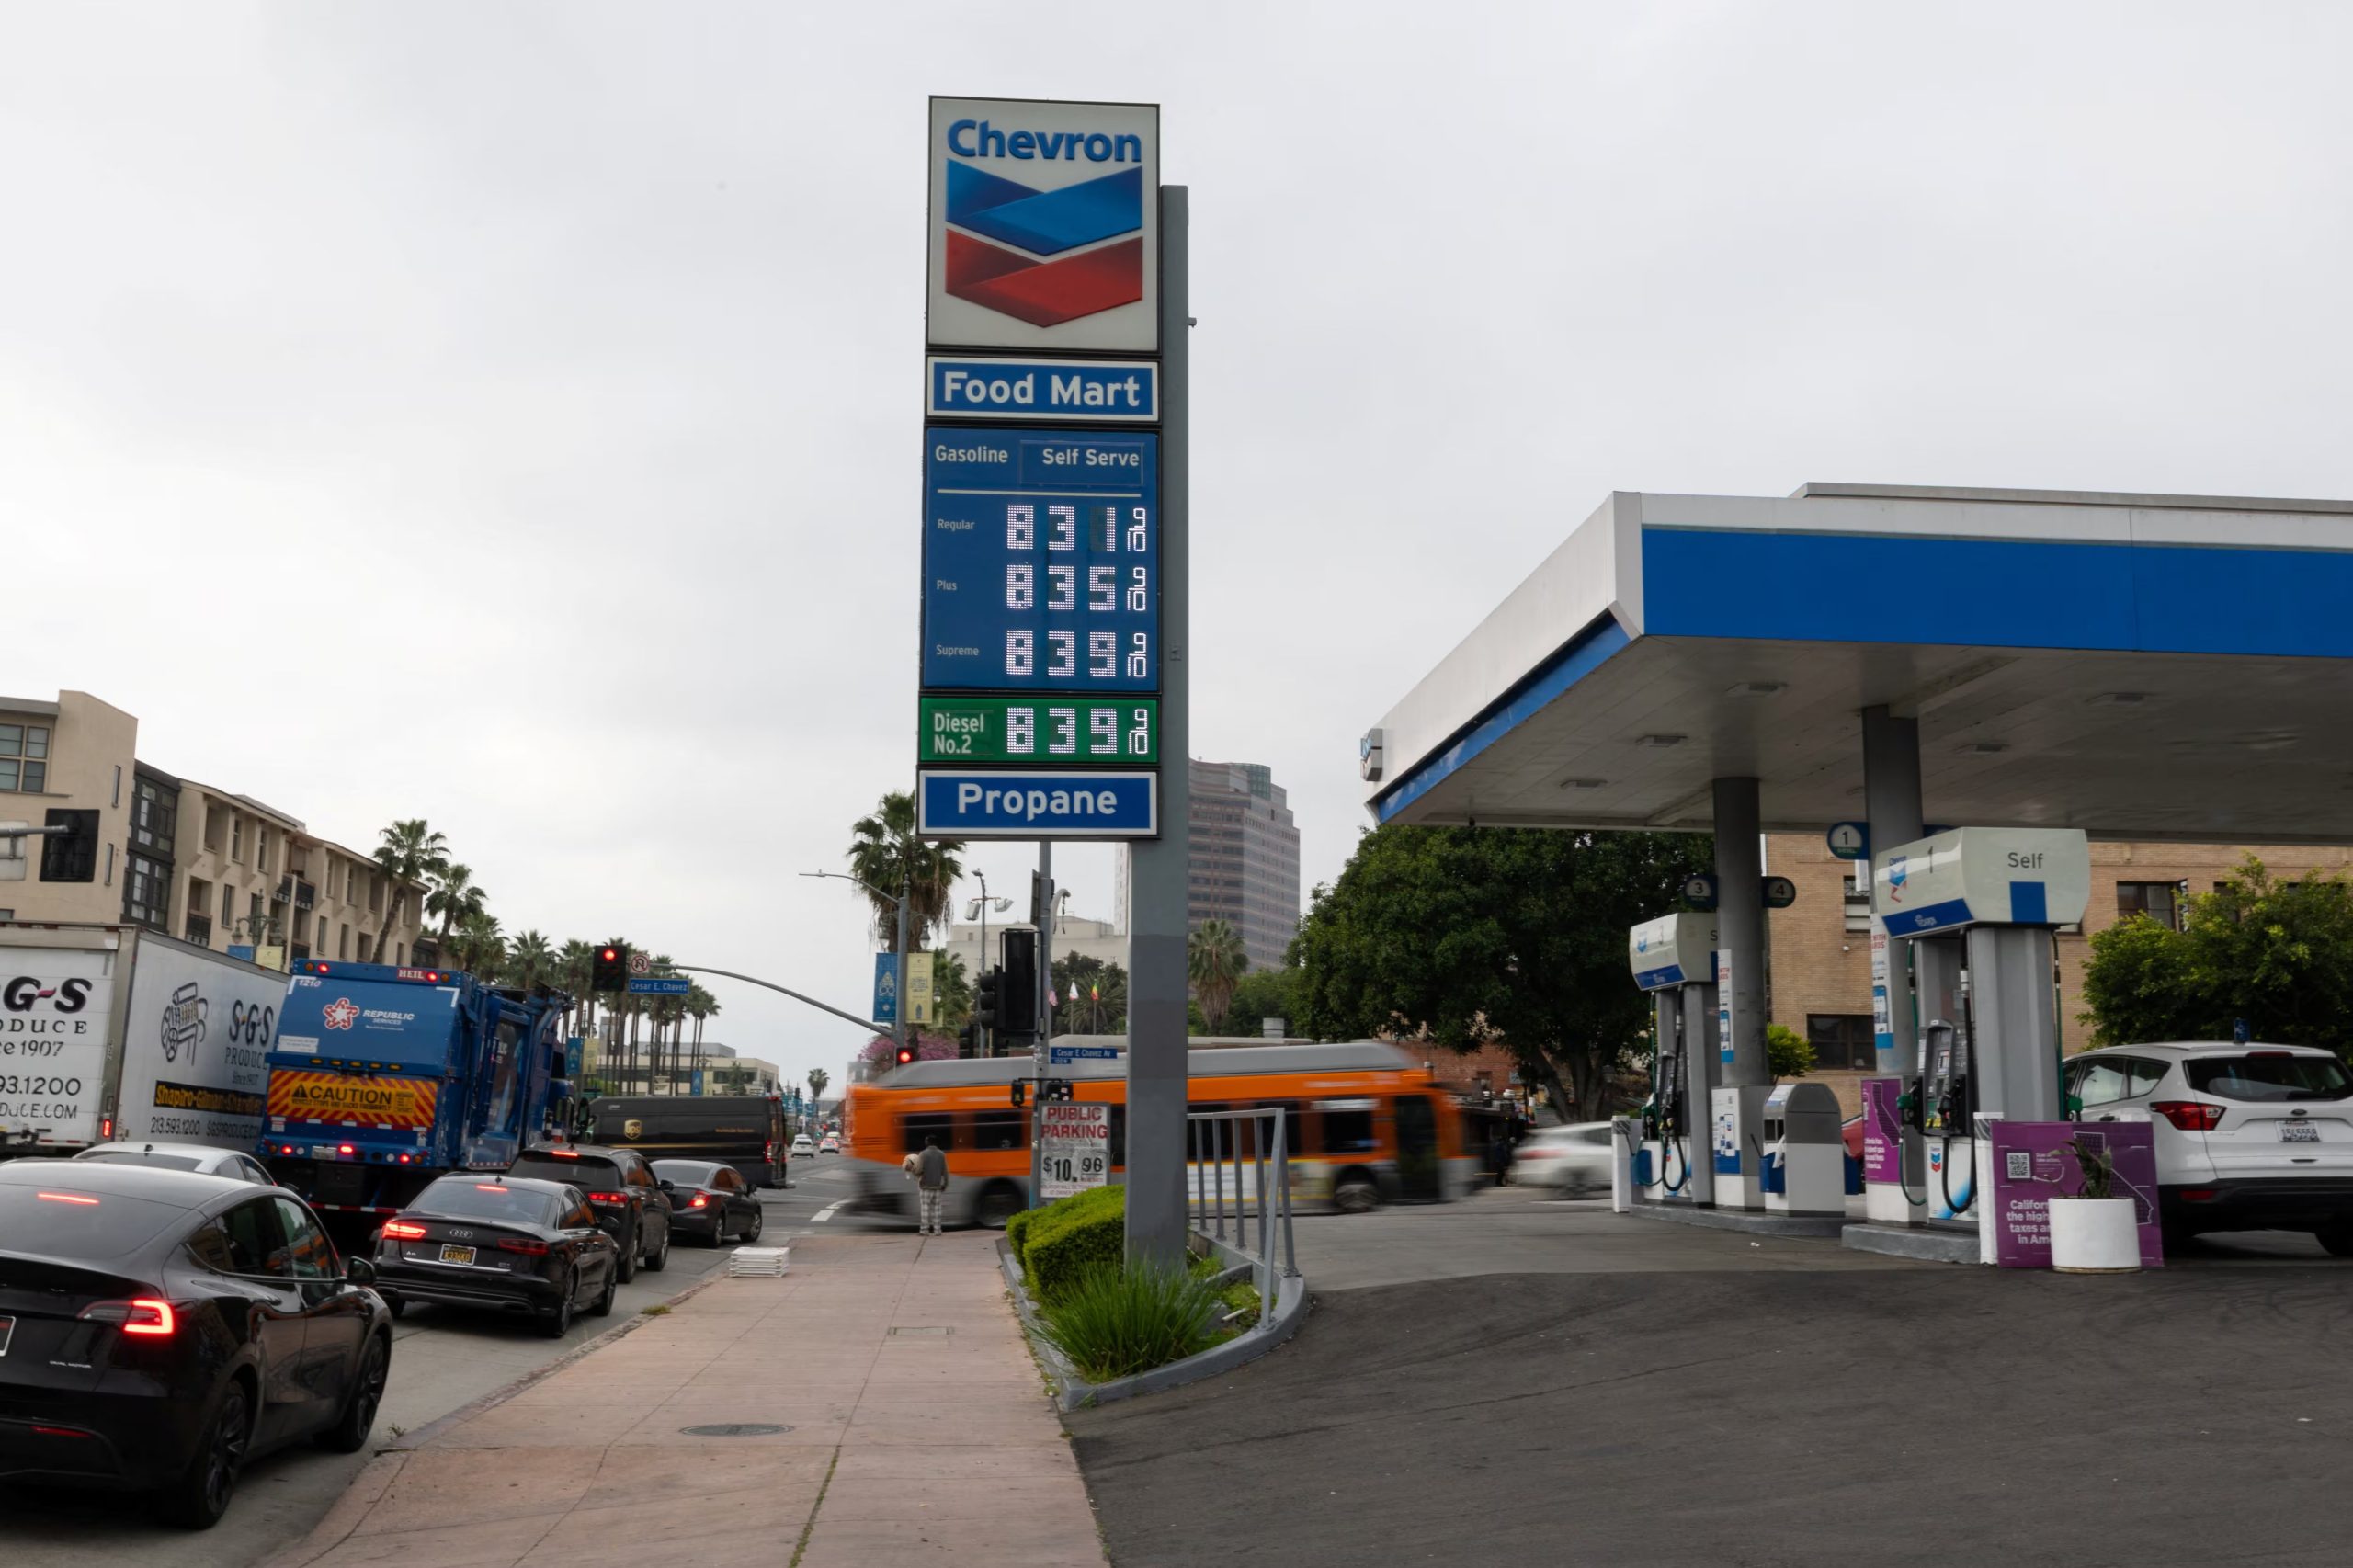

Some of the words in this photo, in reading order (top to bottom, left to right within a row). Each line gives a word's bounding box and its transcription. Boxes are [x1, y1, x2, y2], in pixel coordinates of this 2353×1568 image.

[947, 119, 1142, 163] Chevron
[944, 371, 1035, 404] Food
[1051, 375, 1141, 407] Mart
[935, 445, 1009, 465] Gasoline
[1042, 448, 1079, 466] Self
[1086, 449, 1141, 467] Serve
[937, 518, 975, 531] Regular
[936, 580, 958, 592] Plus
[936, 644, 980, 658] Supreme
[933, 712, 984, 733] Diesel
[933, 734, 972, 755] No.2
[957, 782, 1118, 822] Propane
[1841, 830, 1849, 846] 1
[2007, 851, 2044, 869] Self
[1694, 881, 1704, 894] 3
[1775, 883, 1786, 896] 4
[398, 969, 425, 980] HEIL
[299, 979, 321, 988] 1210
[631, 982, 651, 990] Cesar
[662, 982, 688, 992] Chavez
[362, 1009, 415, 1021] REPUBLIC
[0, 1018, 87, 1035] DUCE
[21, 1040, 64, 1058] 1907
[1056, 1049, 1074, 1057] Cesar
[309, 1085, 392, 1105] CAUTION
[1047, 1106, 1102, 1121] PUBLIC
[1040, 1124, 1108, 1139] PARKING
[2006, 1210, 2024, 1221] the
[2025, 1210, 2051, 1223] high
[2009, 1223, 2039, 1233] taxes
[2018, 1233, 2029, 1244] in
[2029, 1234, 2052, 1244] Am
